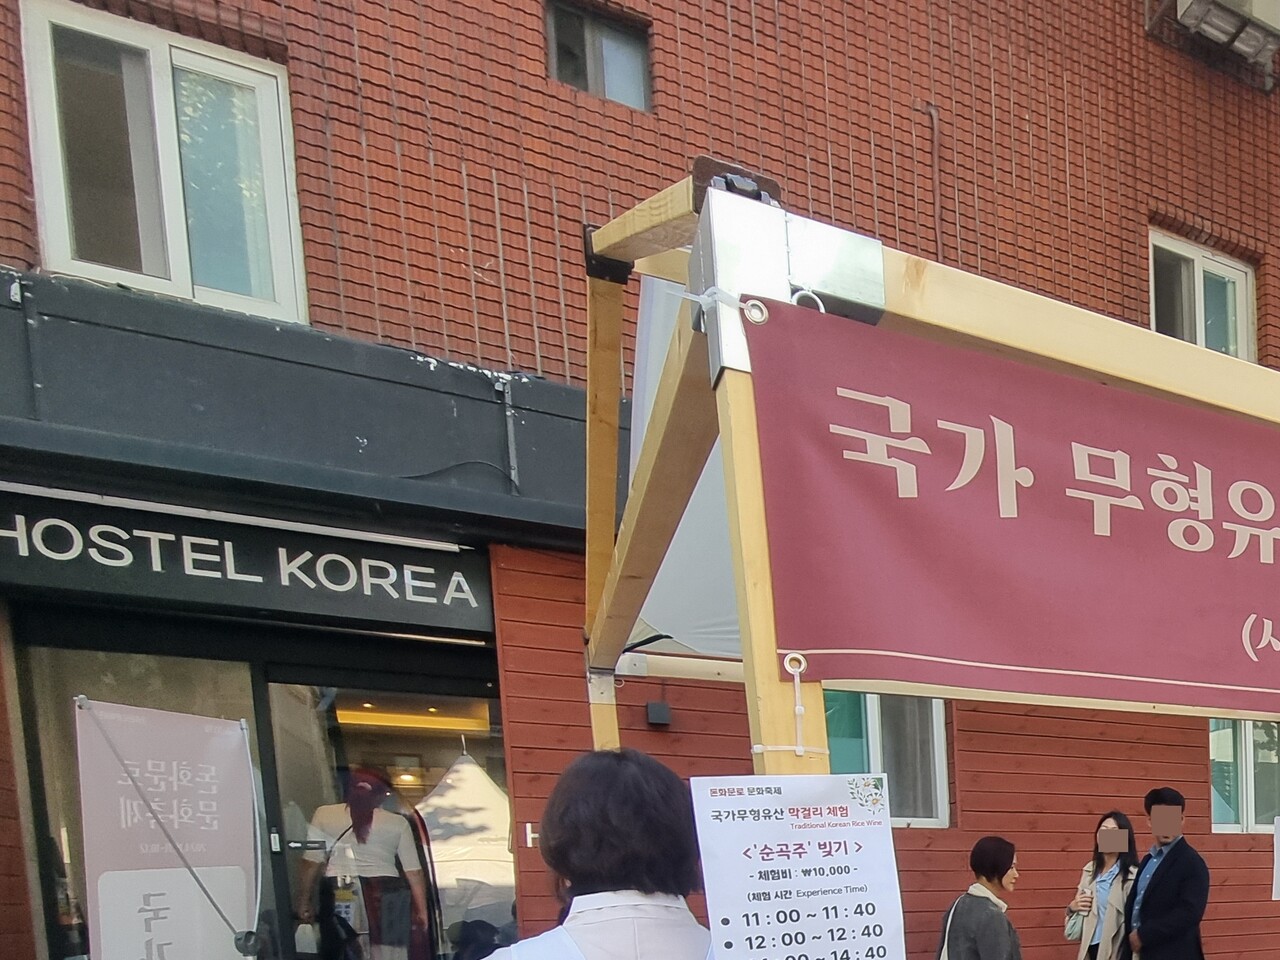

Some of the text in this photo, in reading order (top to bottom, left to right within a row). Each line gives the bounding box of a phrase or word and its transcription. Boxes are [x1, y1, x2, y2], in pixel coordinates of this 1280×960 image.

[829, 386, 1035, 518] 국가
[0, 514, 479, 608] HOSTEL KOREA
[711, 806, 849, 823] 국가무형유산 막걸리 체험
[790, 822, 826, 830] Traditional
[818, 841, 848, 858] 빚기
[757, 868, 792, 882] 체험비
[774, 890, 792, 900] 시간
[796, 887, 842, 899] Experience
[844, 884, 868, 894] Time)
